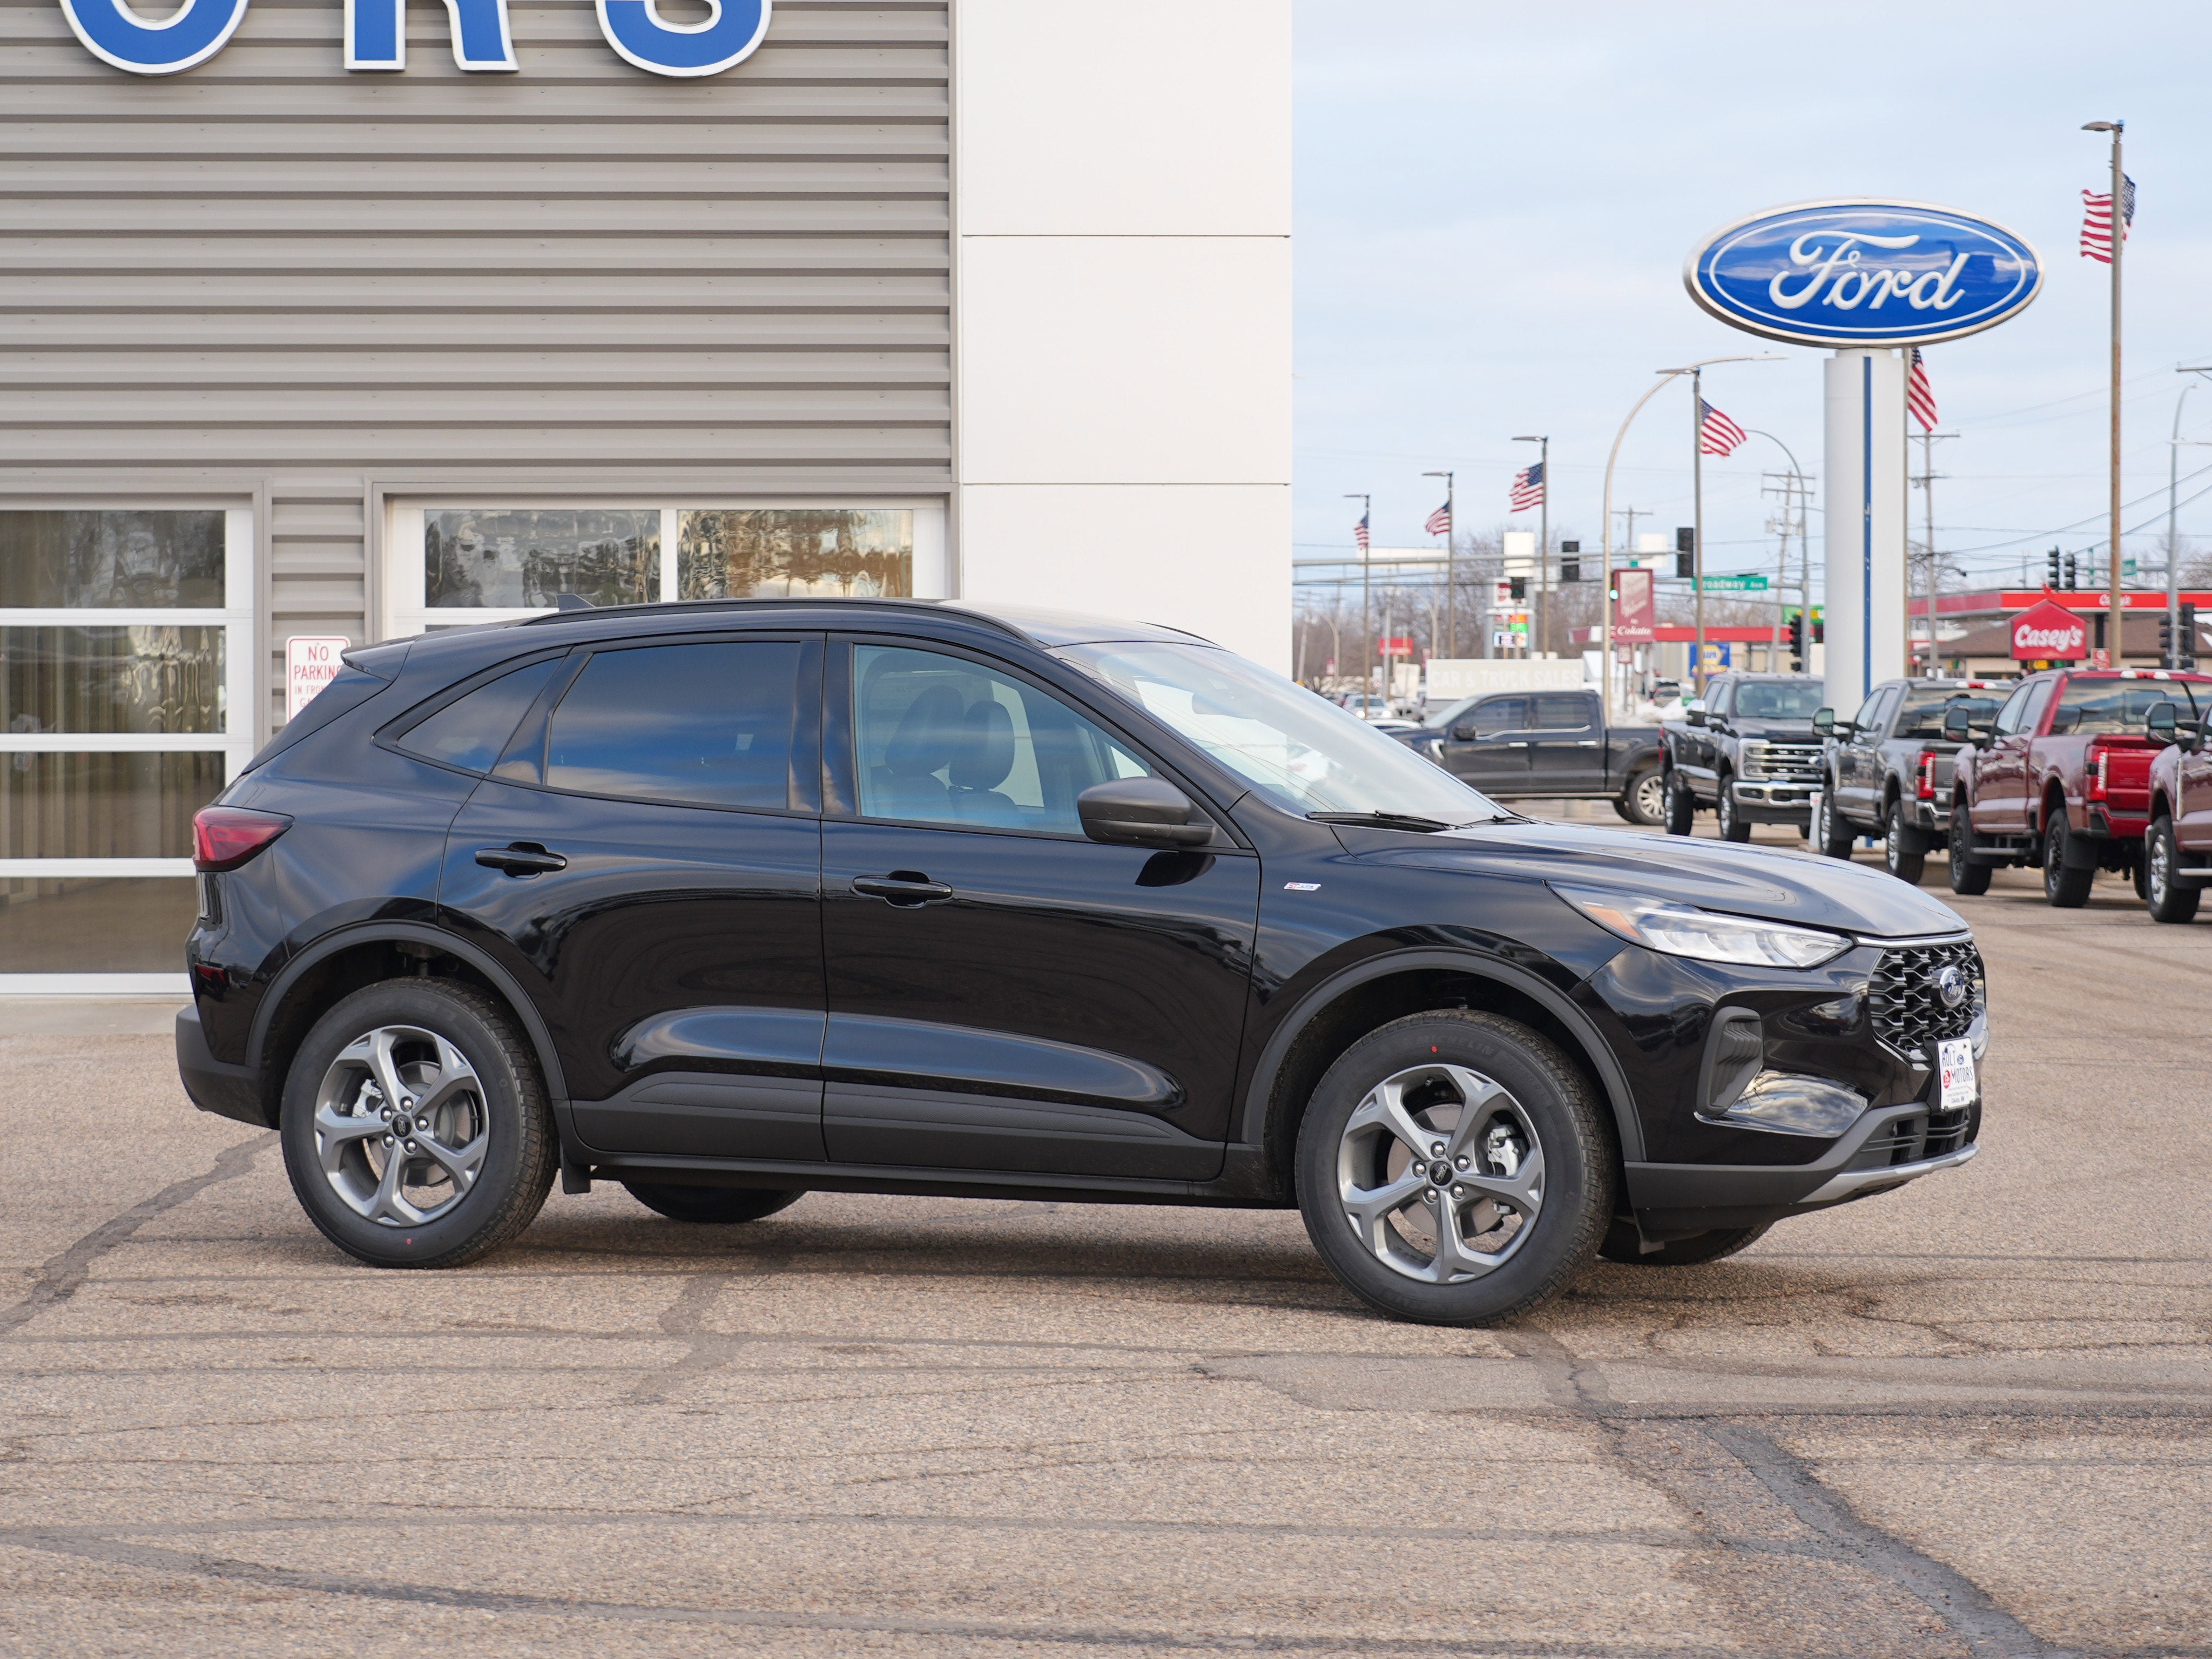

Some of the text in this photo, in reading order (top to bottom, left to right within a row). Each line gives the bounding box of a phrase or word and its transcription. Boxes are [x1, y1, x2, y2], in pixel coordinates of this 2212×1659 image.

[1769, 230, 1970, 310] Ford
[1702, 579, 1746, 590] roadway
[2099, 594, 2132, 606] Cay's
[2014, 624, 2083, 652] Casey's
[308, 646, 329, 661] NO
[1431, 670, 1461, 687] CAR
[1480, 669, 1530, 687] TRUCK
[1533, 669, 1581, 687] SALES
[295, 685, 325, 694] IN FRO
[1951, 1066, 1973, 1084] MOTORS
